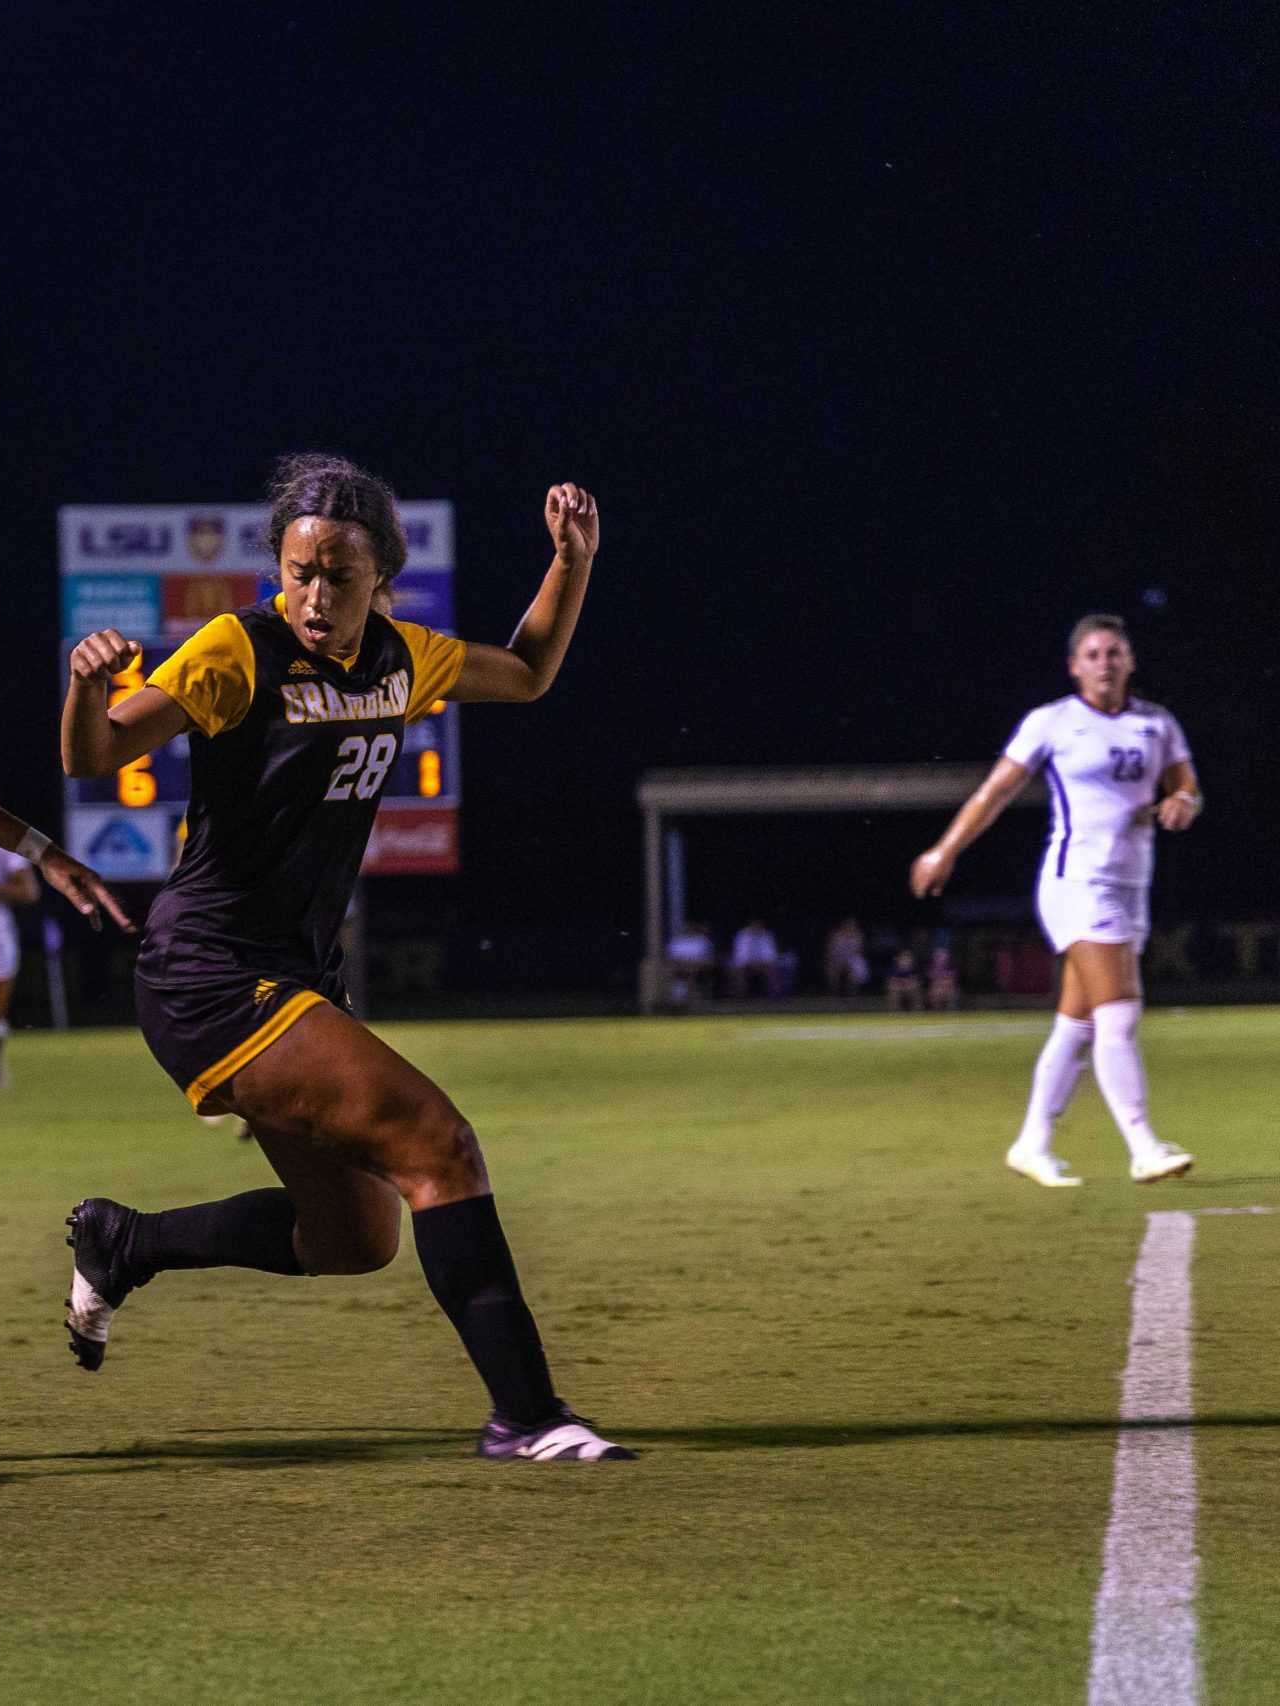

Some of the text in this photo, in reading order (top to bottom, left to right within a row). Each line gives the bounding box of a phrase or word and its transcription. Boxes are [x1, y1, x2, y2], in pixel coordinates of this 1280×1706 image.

[79, 521, 173, 558] LSU
[117, 752, 158, 808] 6
[323, 733, 397, 801] 28
[1109, 746, 1145, 783] 23
